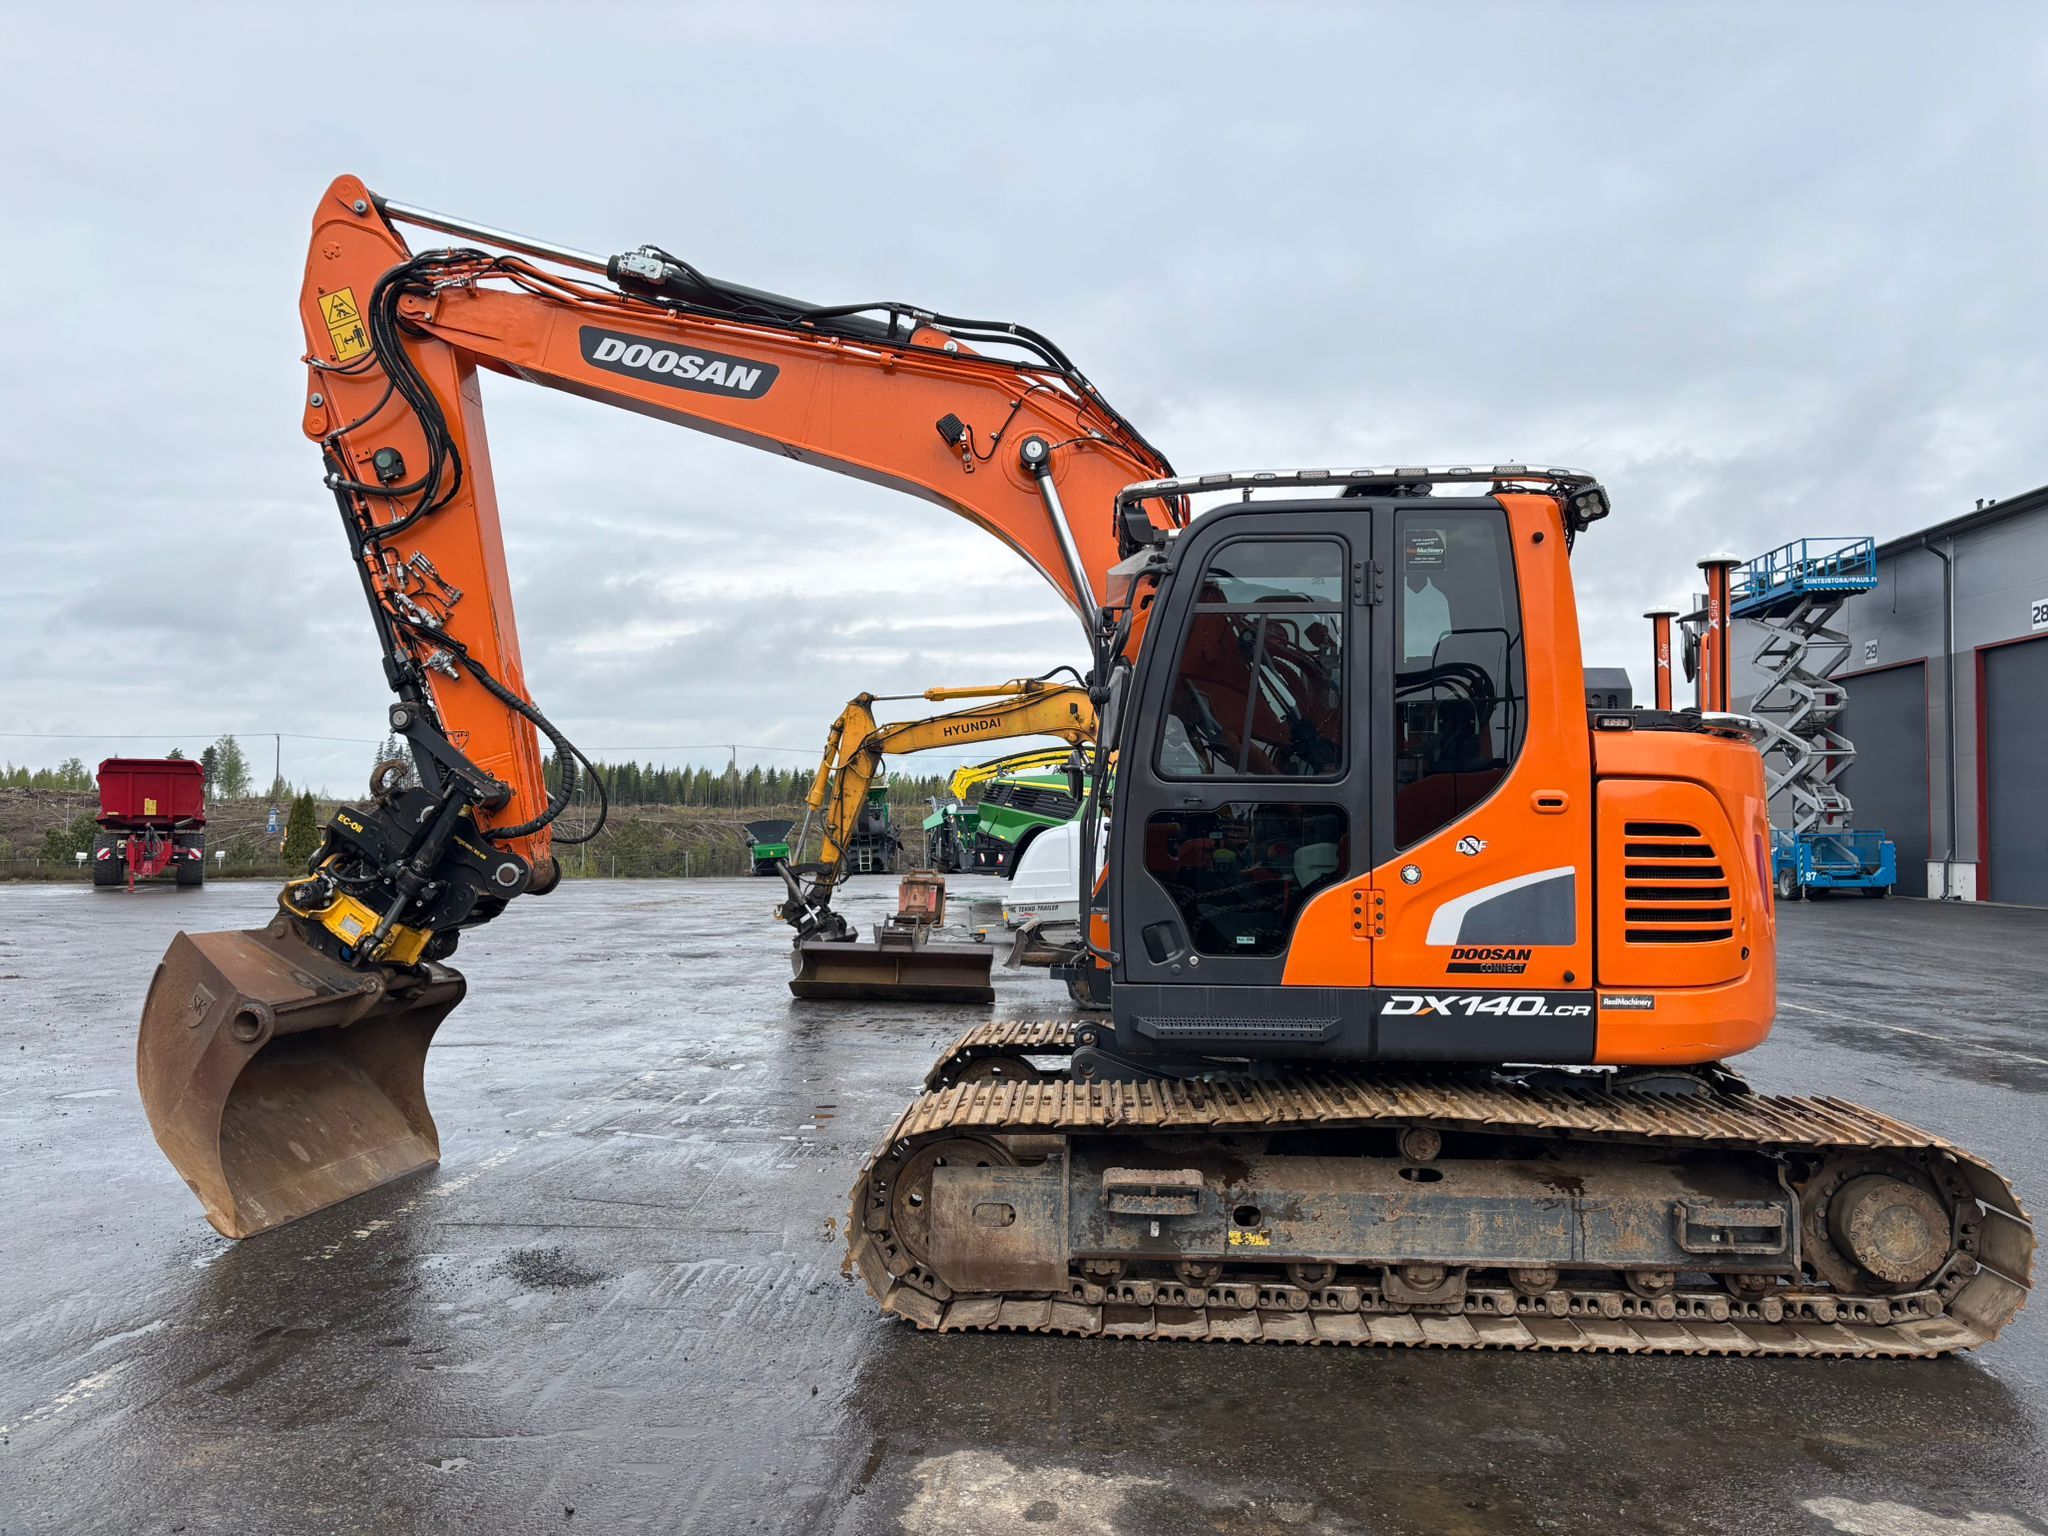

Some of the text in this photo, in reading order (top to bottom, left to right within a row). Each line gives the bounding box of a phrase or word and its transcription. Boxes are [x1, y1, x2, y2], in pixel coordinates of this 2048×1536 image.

[592, 337, 762, 391] DOOSAN
[2032, 604, 2048, 624] 28
[1865, 644, 1877, 660] 29
[943, 717, 1001, 737] HYUNDAI
[1806, 872, 1817, 881] 97
[1450, 948, 1532, 961] DOOSAN
[1479, 963, 1524, 973] CONNECT
[1603, 997, 1652, 1008] RealMachinery
